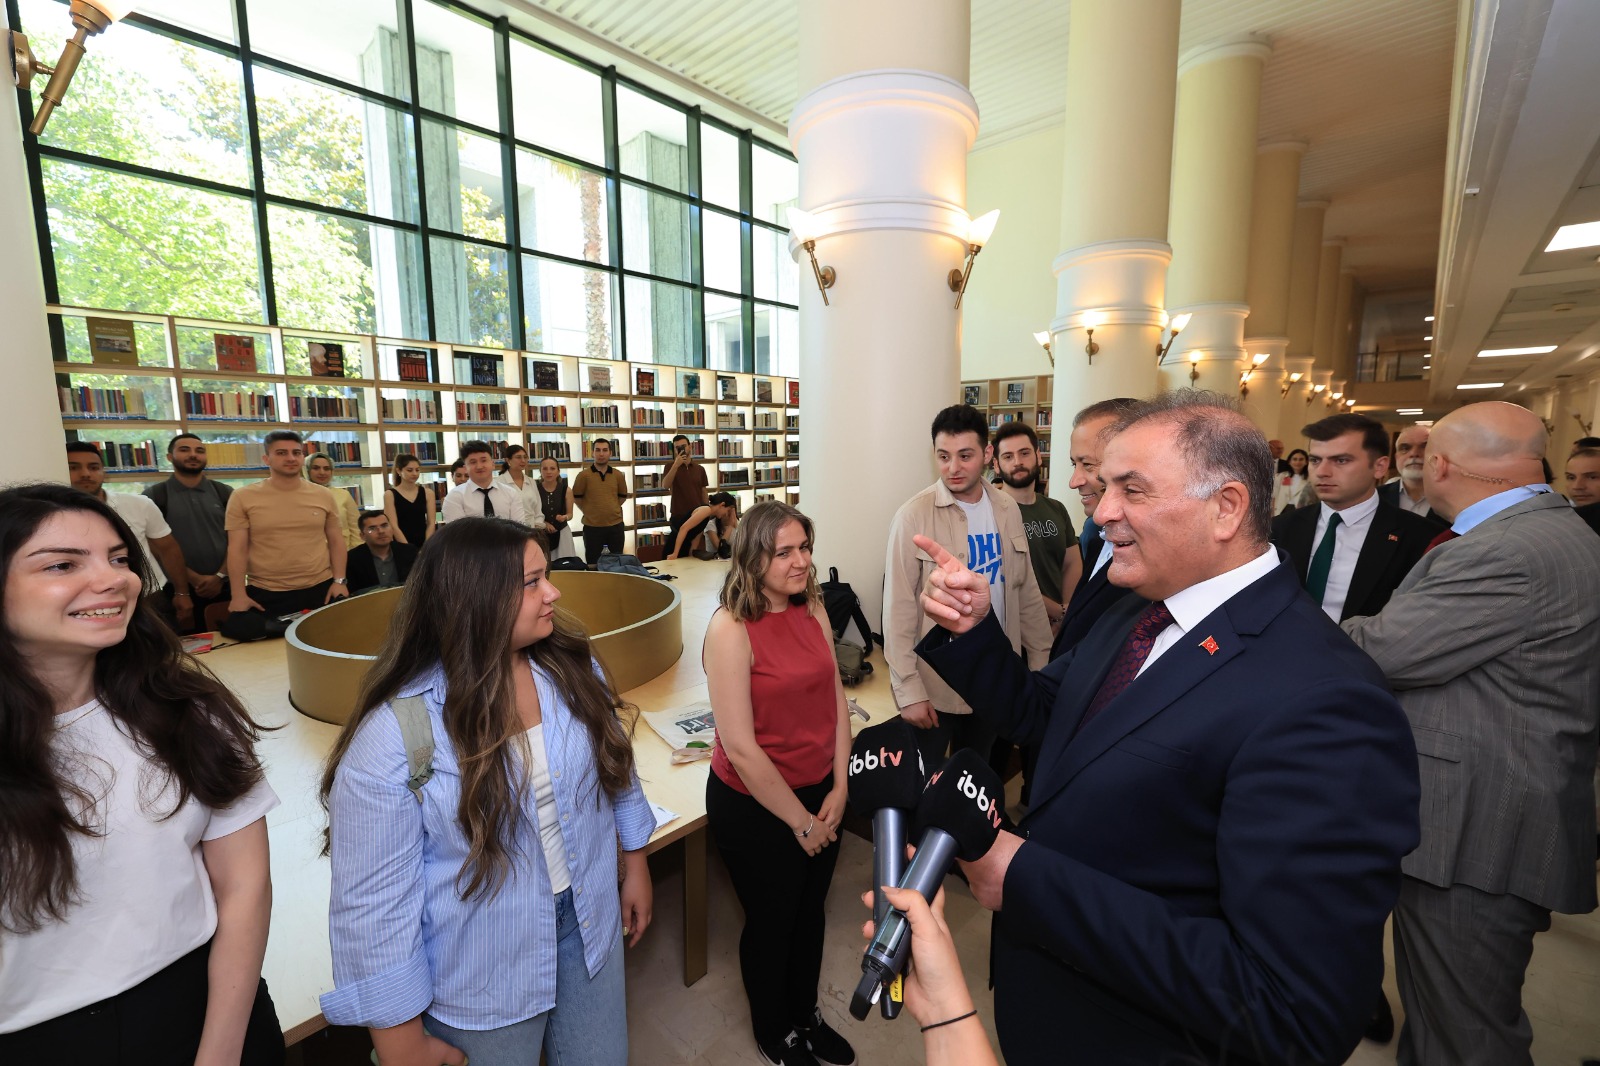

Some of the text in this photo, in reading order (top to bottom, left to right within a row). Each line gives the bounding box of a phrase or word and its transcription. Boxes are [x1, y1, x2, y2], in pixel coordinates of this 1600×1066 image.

[1023, 519, 1059, 540] POLO
[849, 746, 903, 777] ibbtv
[956, 769, 1003, 829] ibbtv
